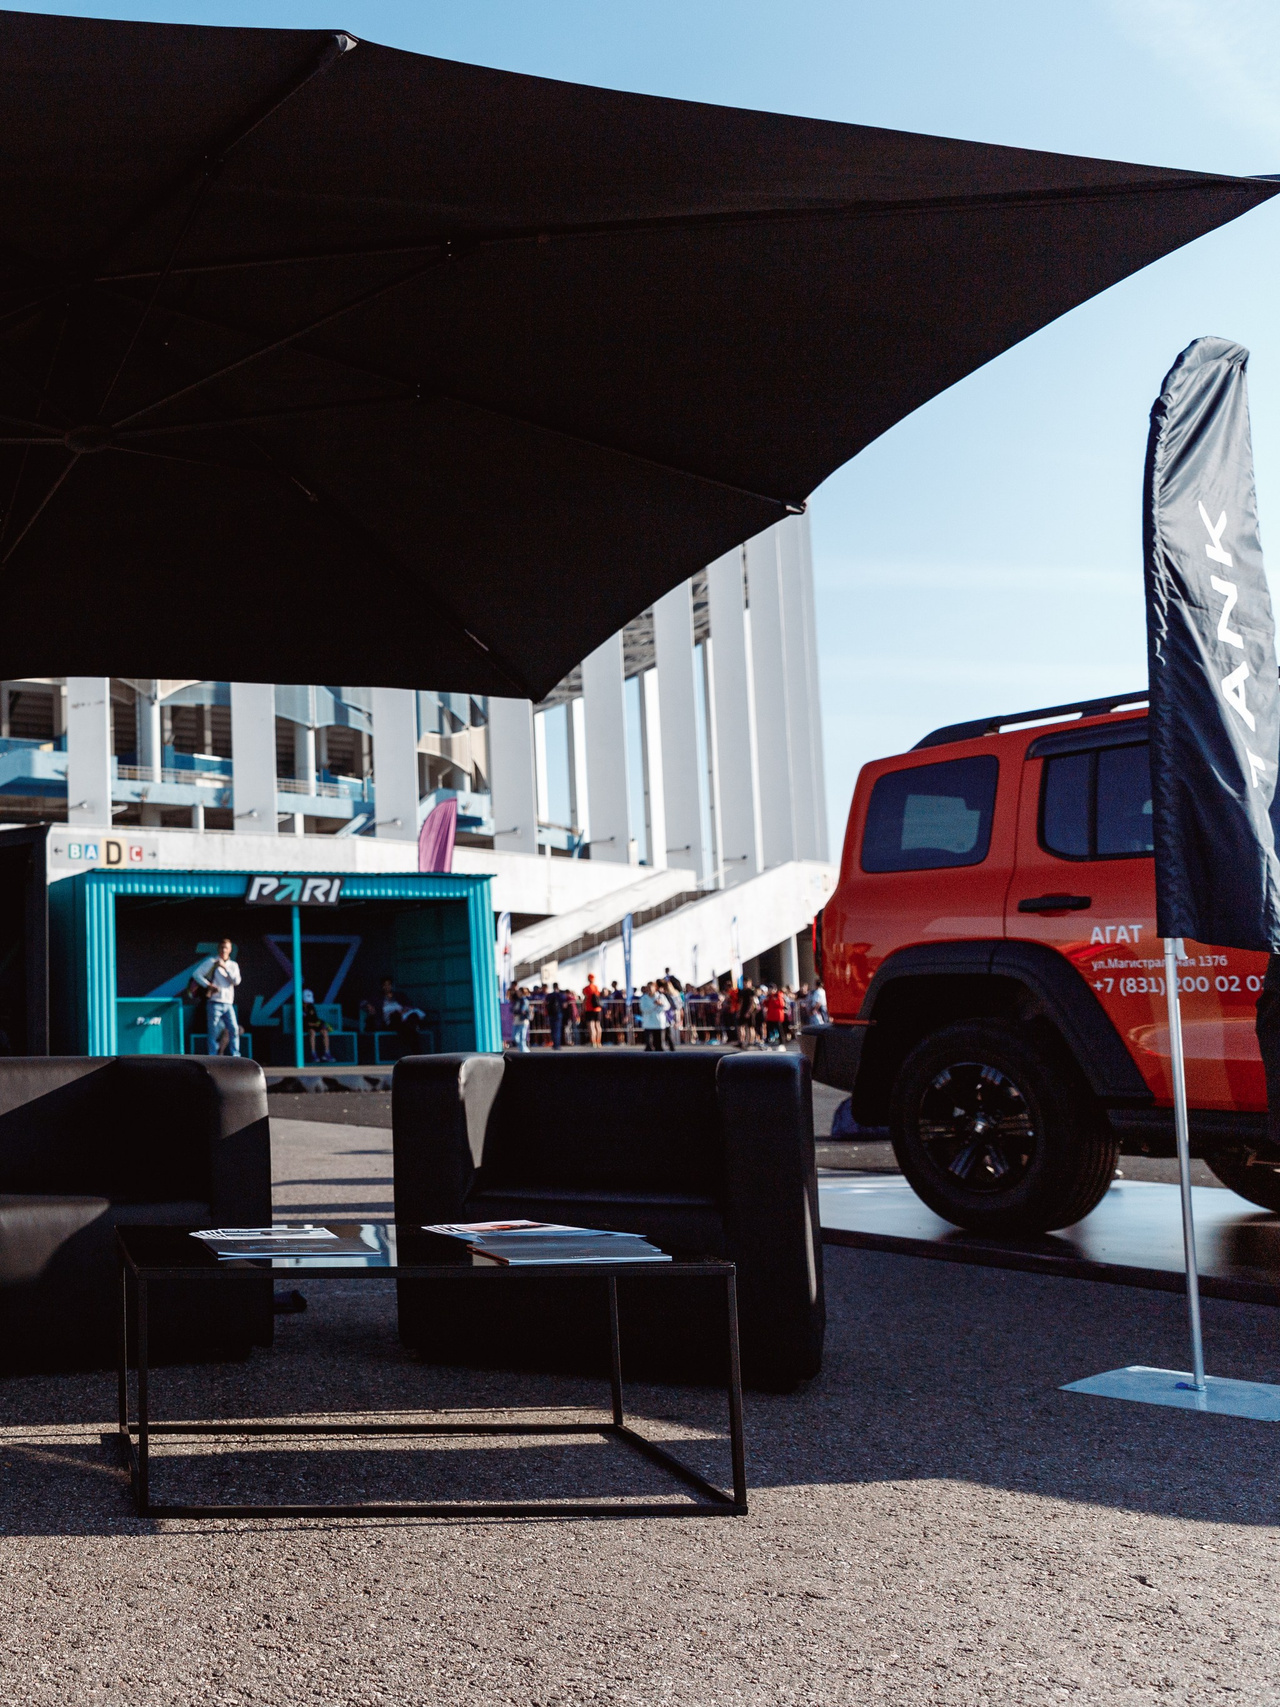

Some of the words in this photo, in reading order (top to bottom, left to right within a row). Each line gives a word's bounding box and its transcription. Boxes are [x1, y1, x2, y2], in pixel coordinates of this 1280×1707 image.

[70, 843, 81, 859] B
[85, 845, 98, 860] A
[106, 840, 122, 866] D
[131, 846, 142, 862] C
[248, 876, 341, 903] PARI
[1090, 925, 1143, 945] АГАТ
[1091, 957, 1197, 972] ул.Магистралная
[1093, 977, 1115, 994] +7
[1119, 976, 1166, 997] (831)
[1215, 975, 1242, 992] 02
